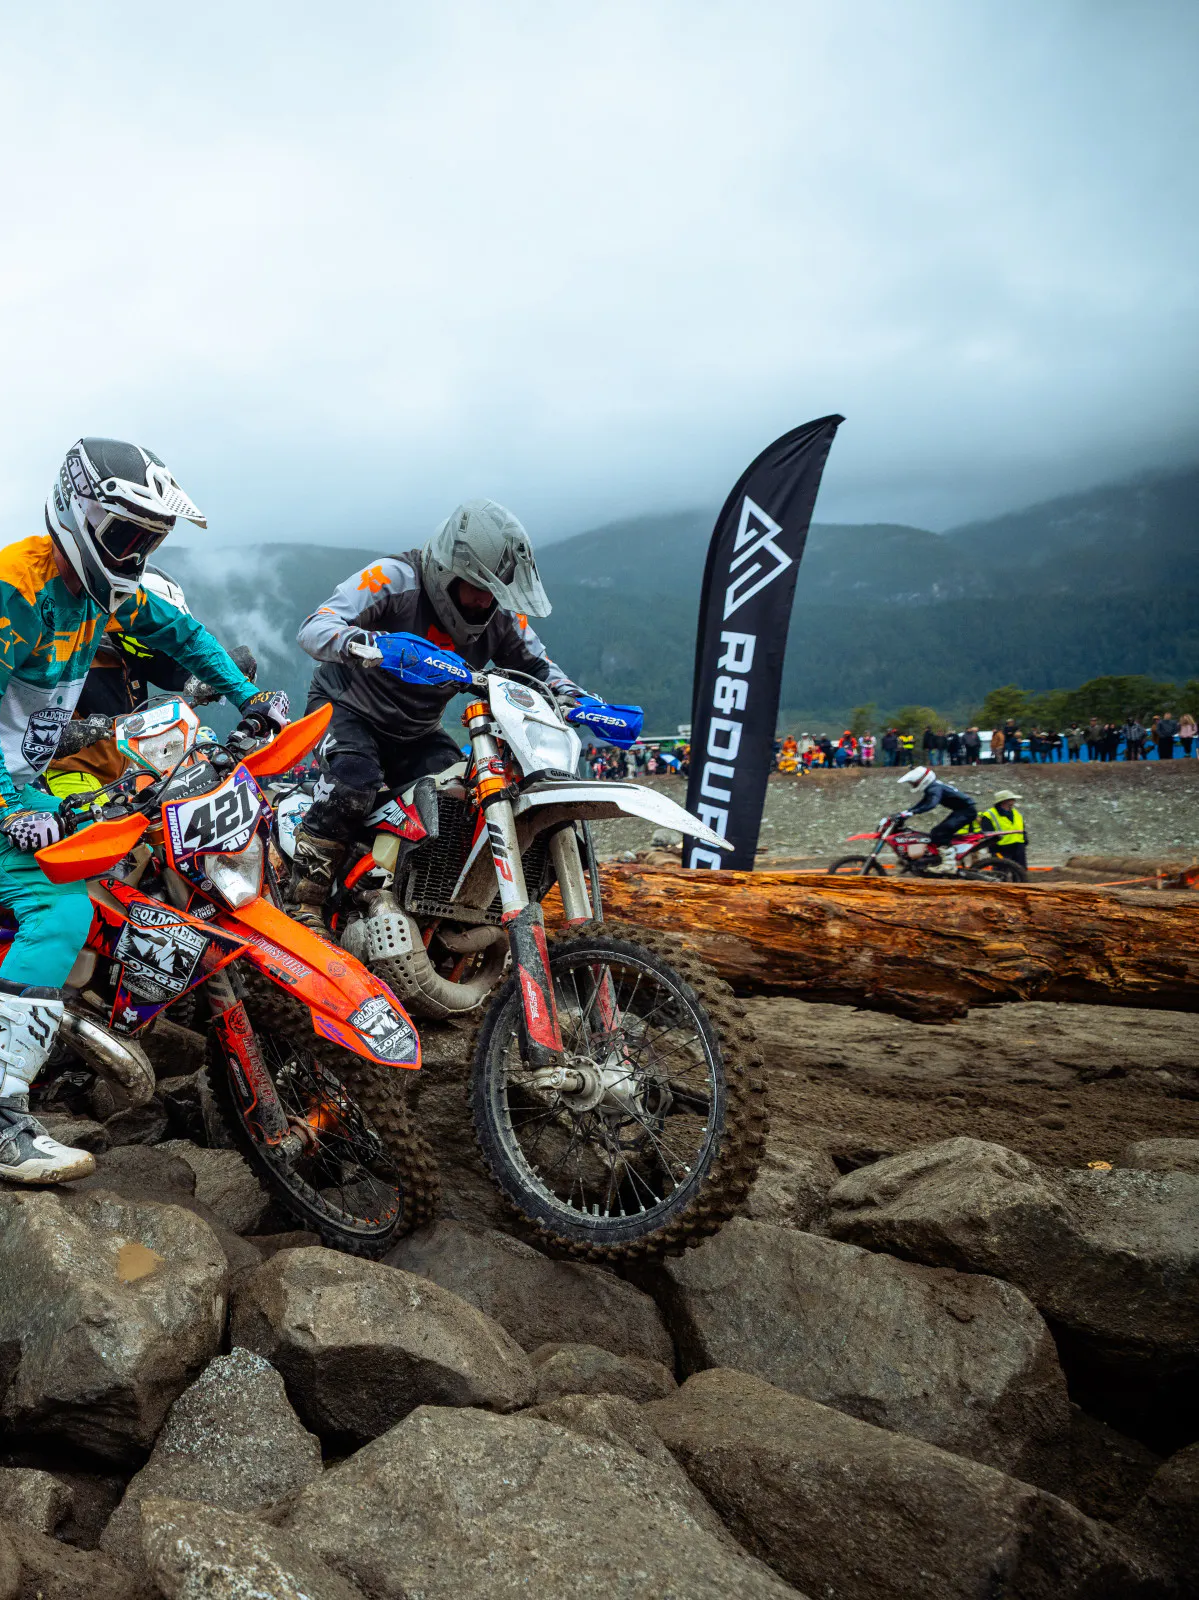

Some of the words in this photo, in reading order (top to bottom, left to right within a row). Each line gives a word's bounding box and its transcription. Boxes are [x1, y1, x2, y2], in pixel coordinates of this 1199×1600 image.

[165, 805, 184, 855] MCCAHILL
[184, 781, 254, 848] 421
[117, 954, 185, 992] LODGE
[374, 1026, 412, 1053] LODGE
